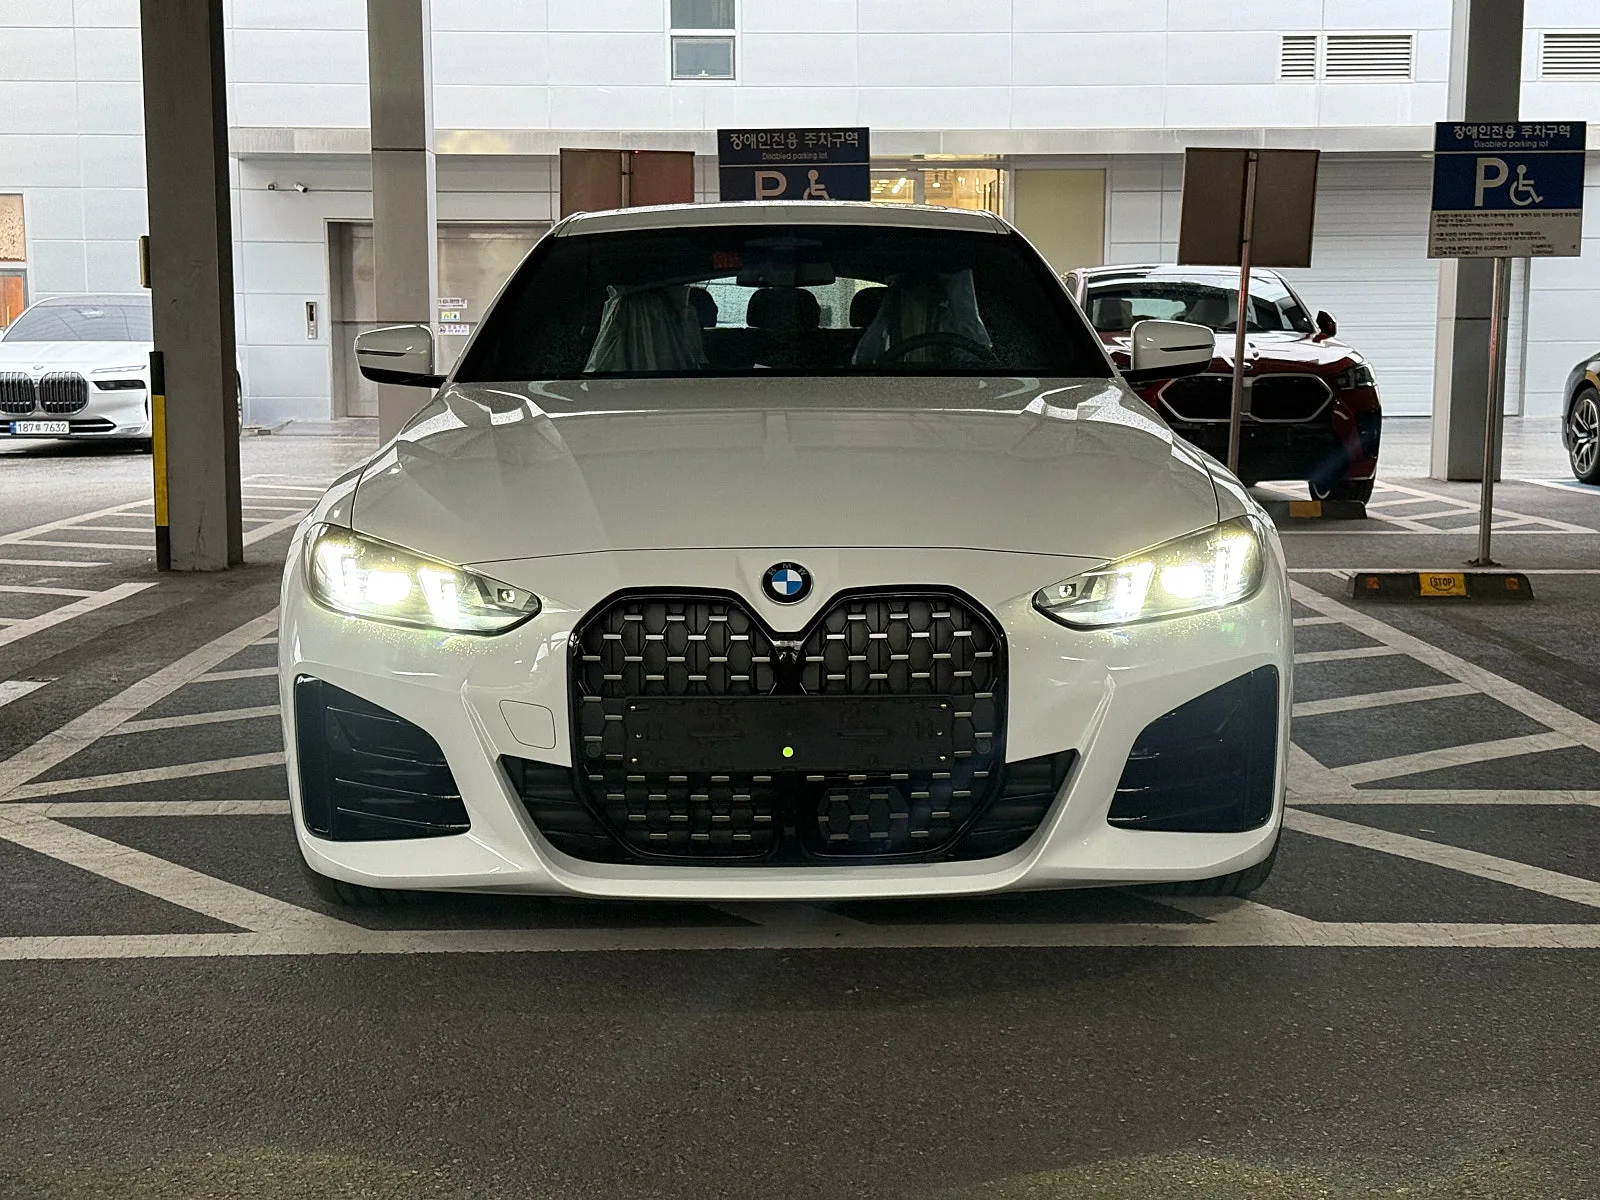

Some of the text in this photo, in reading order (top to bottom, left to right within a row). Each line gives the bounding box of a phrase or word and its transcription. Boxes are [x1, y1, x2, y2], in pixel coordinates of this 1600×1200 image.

[1453, 124, 1571, 140] 장애인전용 주차구역
[730, 131, 859, 150] 장애인전용 주차구역
[1474, 140, 1549, 149] Disabled parking lot
[762, 151, 828, 161] Disabled parking lot
[754, 170, 787, 200] P
[1474, 157, 1509, 207] P
[43, 423, 67, 433] 7632
[767, 563, 808, 576] BMW
[1432, 577, 1452, 587] STOP
